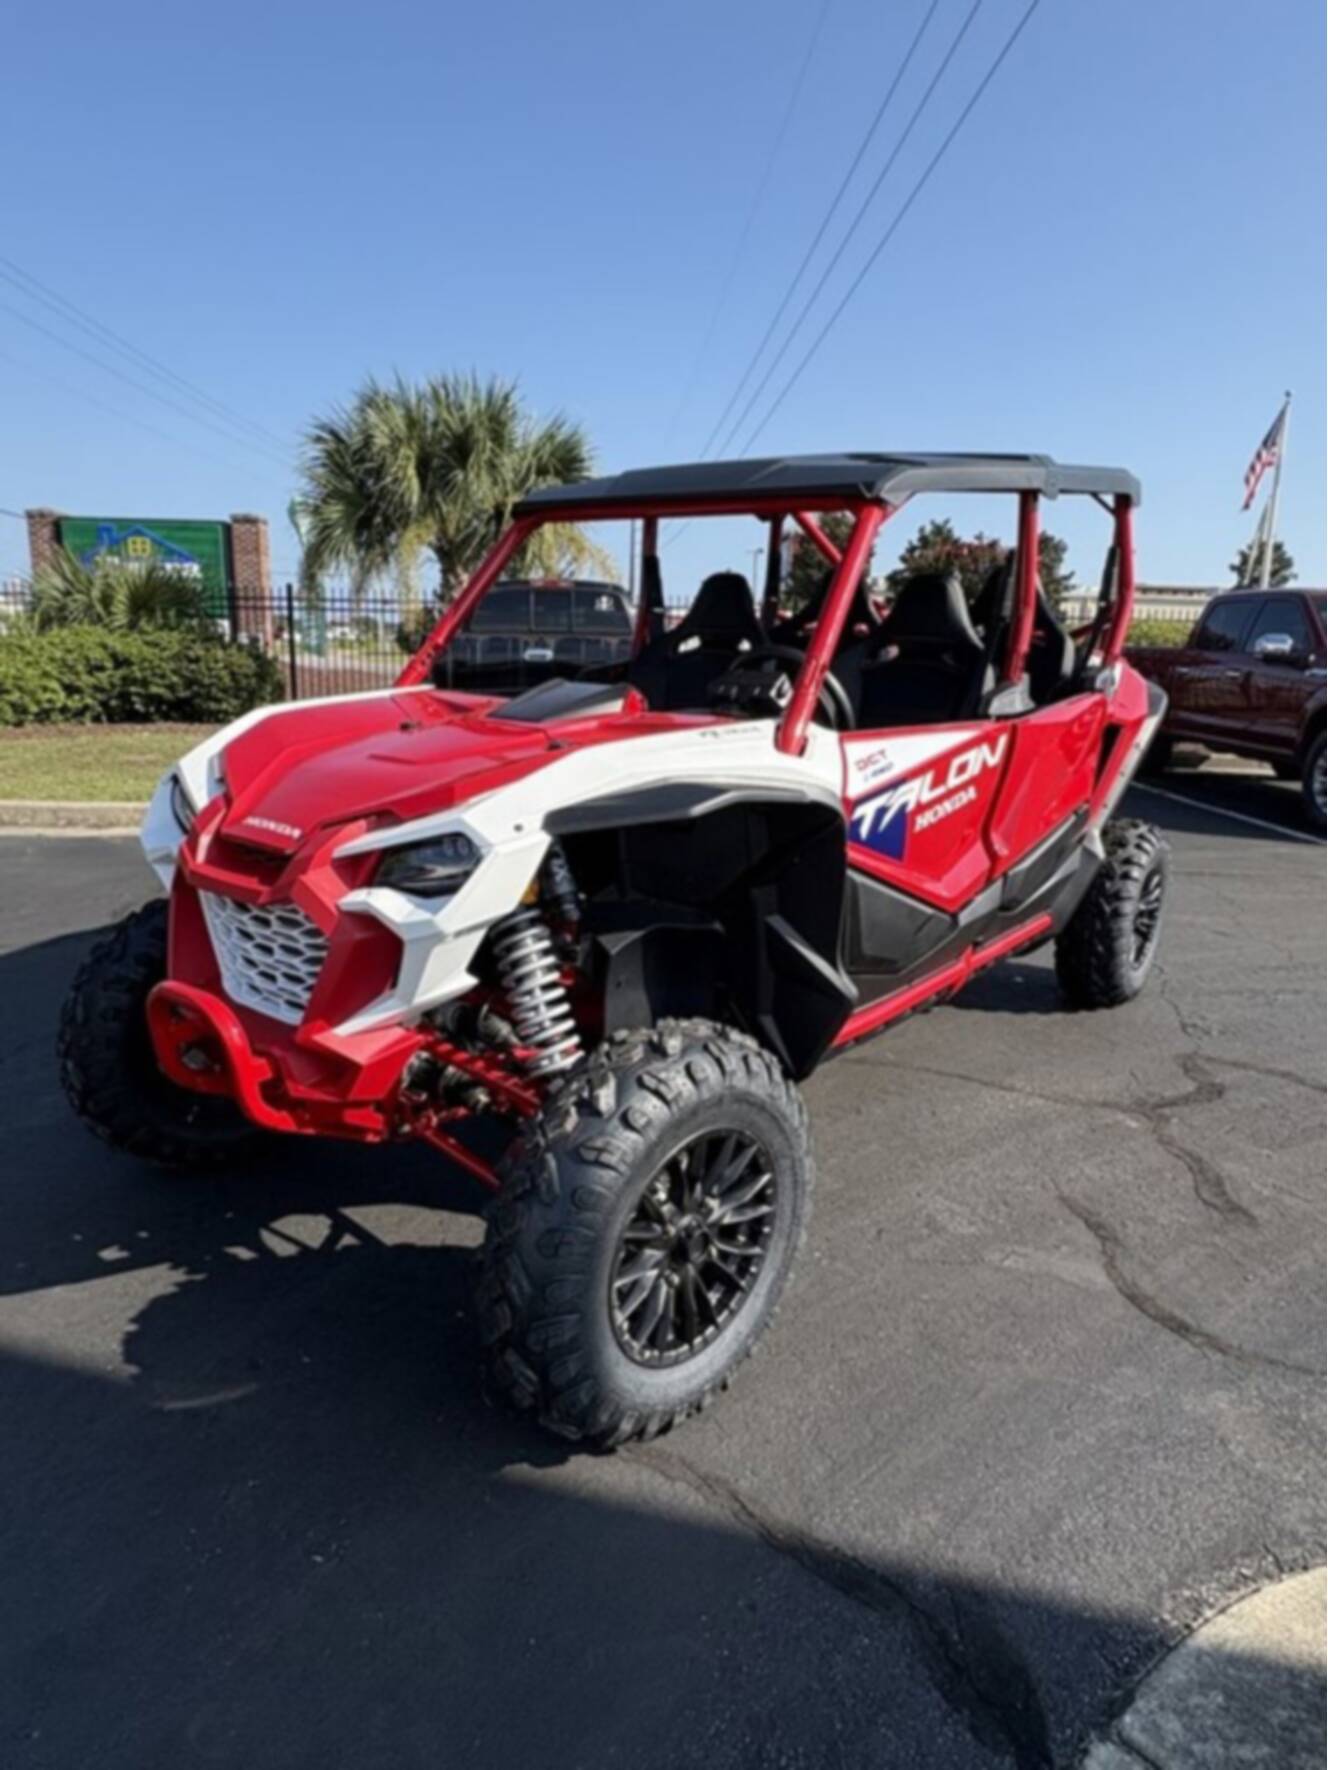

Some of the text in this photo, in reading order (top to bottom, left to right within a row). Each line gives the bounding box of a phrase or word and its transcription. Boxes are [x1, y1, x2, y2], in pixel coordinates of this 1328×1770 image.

[851, 734, 1008, 841] TALON
[914, 786, 977, 832] HONDA
[243, 817, 302, 839] HONDA
